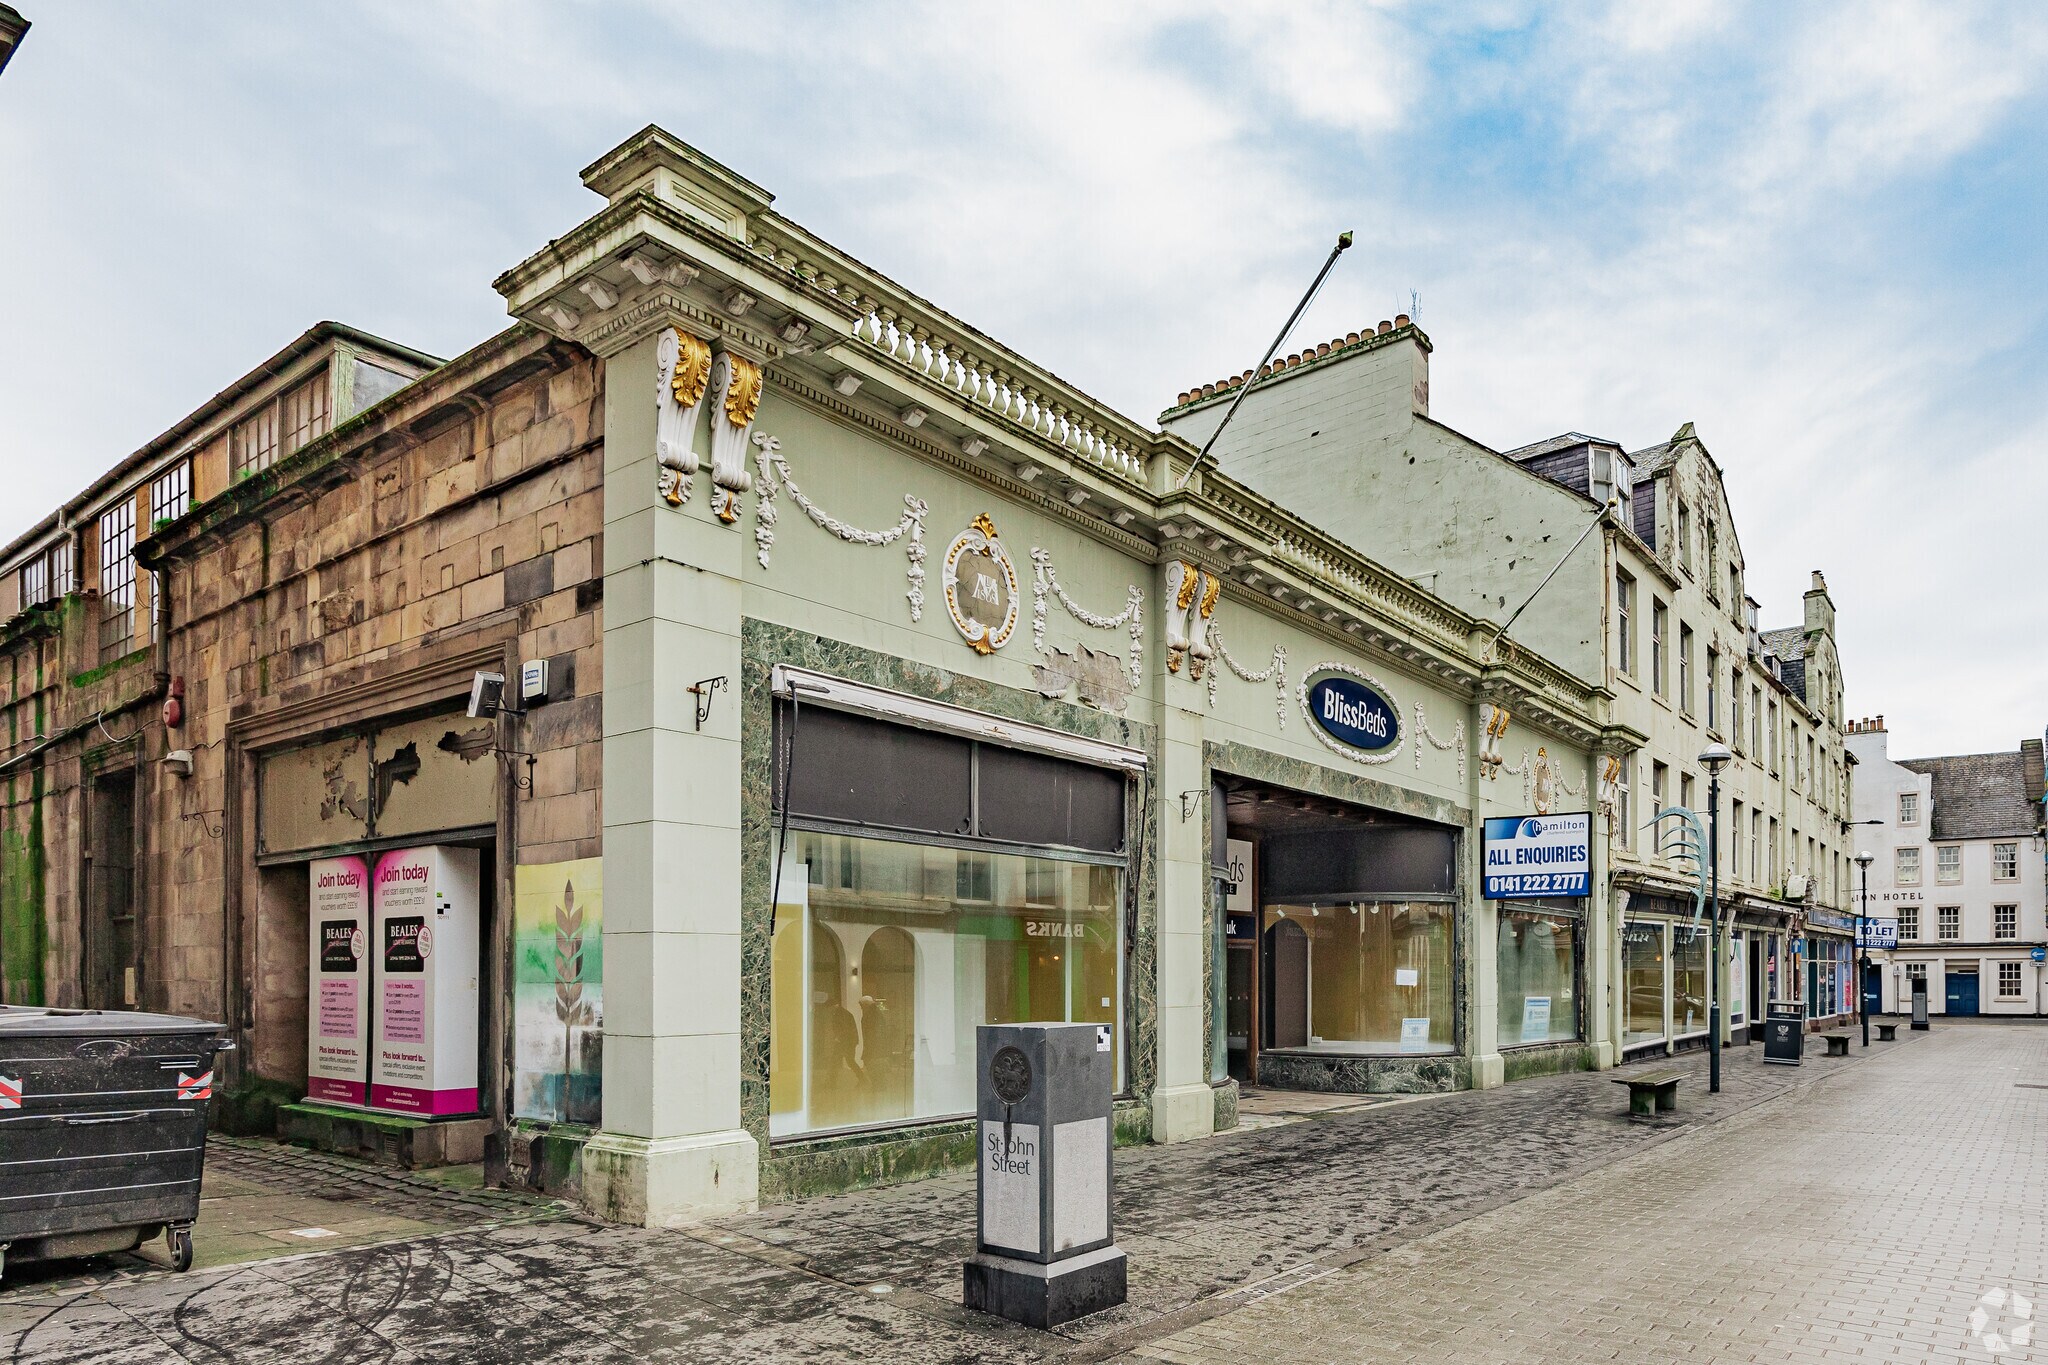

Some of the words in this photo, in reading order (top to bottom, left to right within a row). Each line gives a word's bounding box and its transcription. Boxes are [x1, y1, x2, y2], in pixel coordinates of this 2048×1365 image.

[1324, 688, 1387, 738] BlissBeds
[1534, 820, 1585, 833] hamilton
[1488, 849, 1512, 866] ALL
[1516, 845, 1586, 865] ENQUIRIES
[318, 873, 335, 888] Join
[337, 870, 361, 889] today
[381, 866, 400, 883] Join
[402, 863, 429, 883] today
[1489, 877, 1520, 892] 0141
[1523, 875, 1550, 891] 222
[1553, 874, 1585, 890] 2777
[1883, 893, 1924, 901] HOTEL
[326, 927, 352, 939] BEALES
[390, 924, 419, 937] BEALES
[1876, 926, 1894, 936] LET
[328, 1046, 336, 1054] look
[336, 1047, 351, 1056] forward
[382, 1051, 391, 1059] Plus
[391, 1051, 401, 1060] look
[401, 1052, 418, 1061] forward
[992, 1153, 1031, 1176] Street
